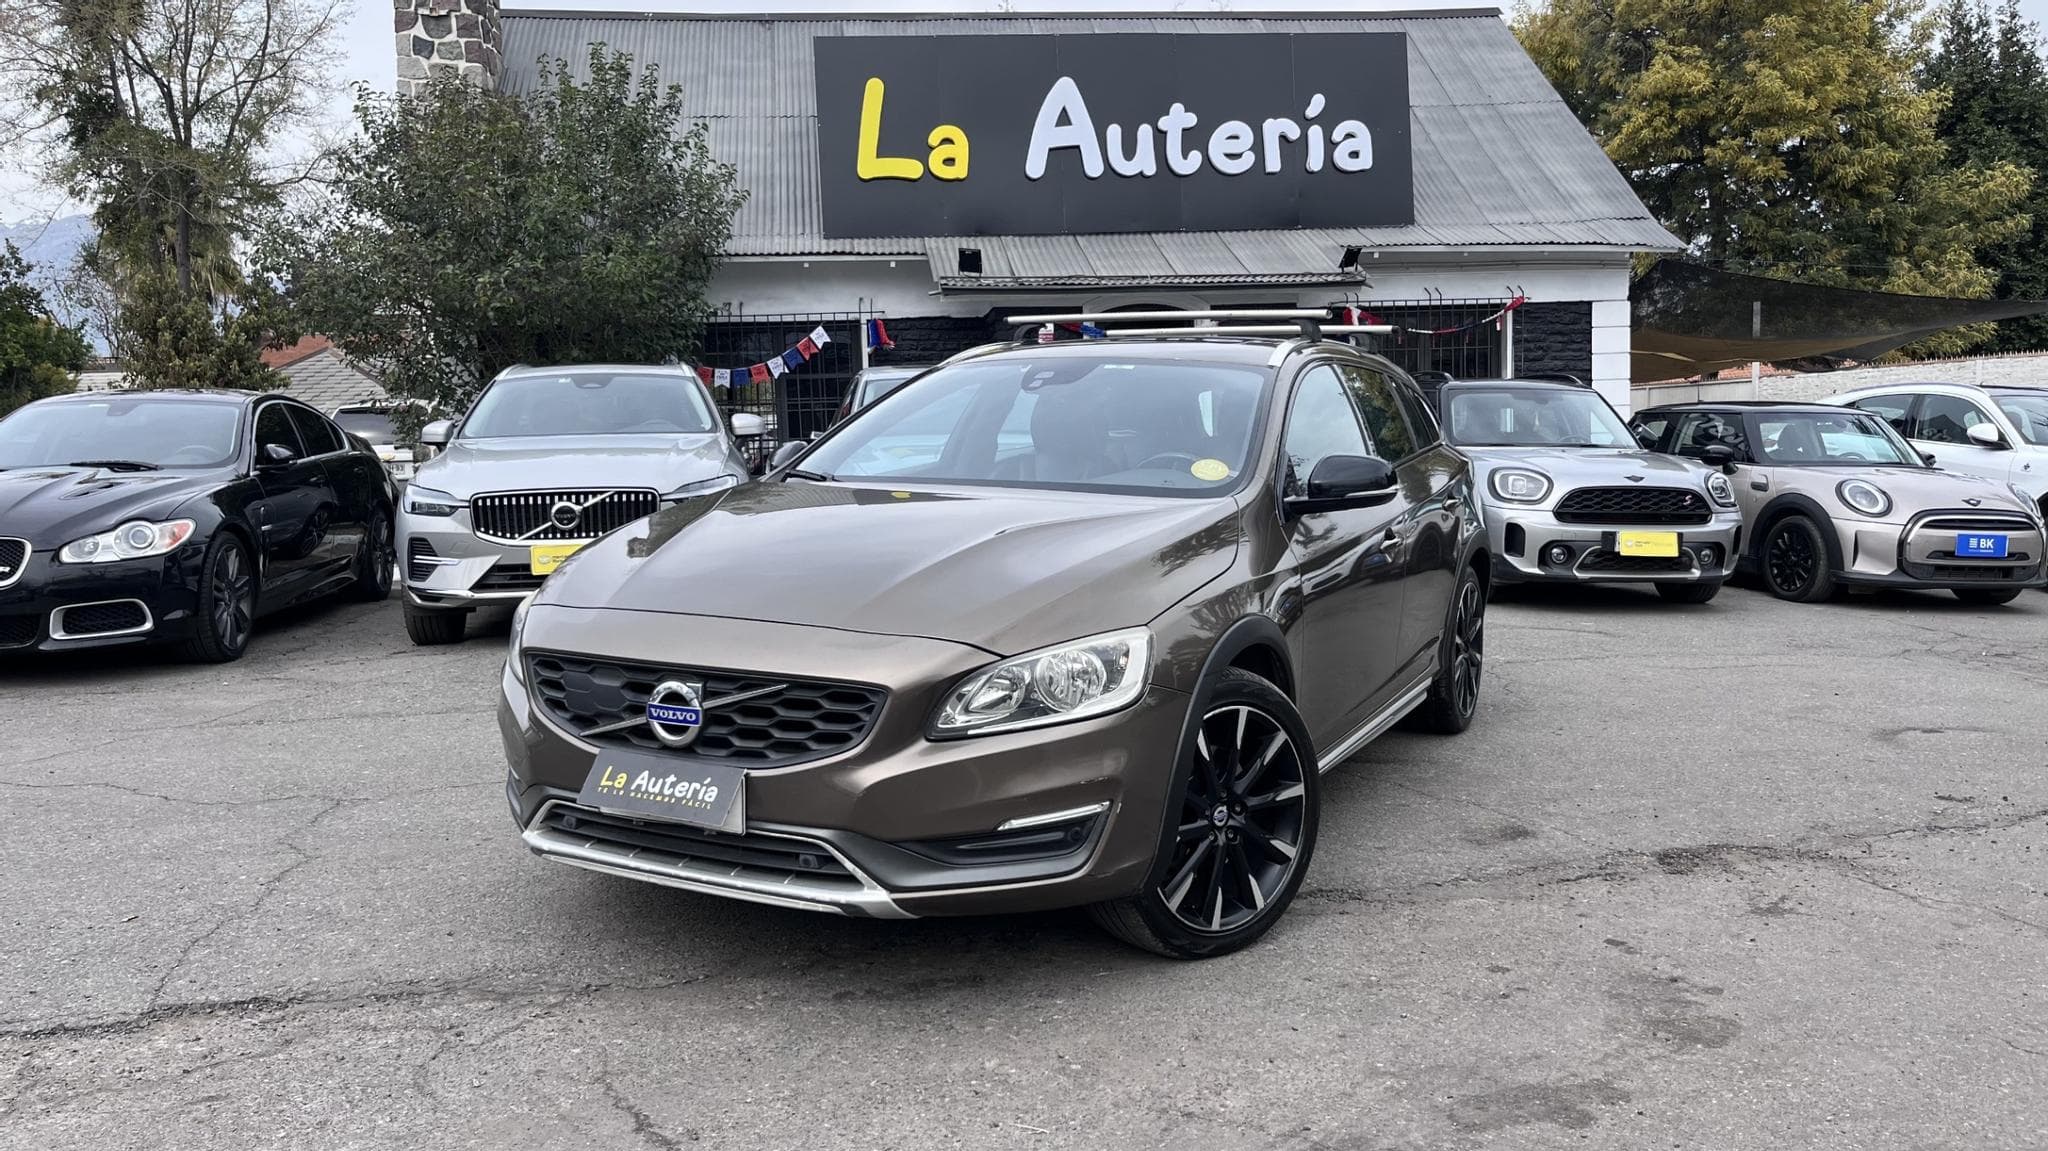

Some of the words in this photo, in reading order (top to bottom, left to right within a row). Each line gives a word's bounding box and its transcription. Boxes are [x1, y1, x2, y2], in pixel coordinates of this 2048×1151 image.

[857, 77, 969, 181] La
[1025, 76, 1373, 179] Autería
[1979, 538, 1995, 549] BK
[650, 707, 696, 721] VOLVO
[600, 766, 628, 788] La
[630, 770, 718, 802] Autería
